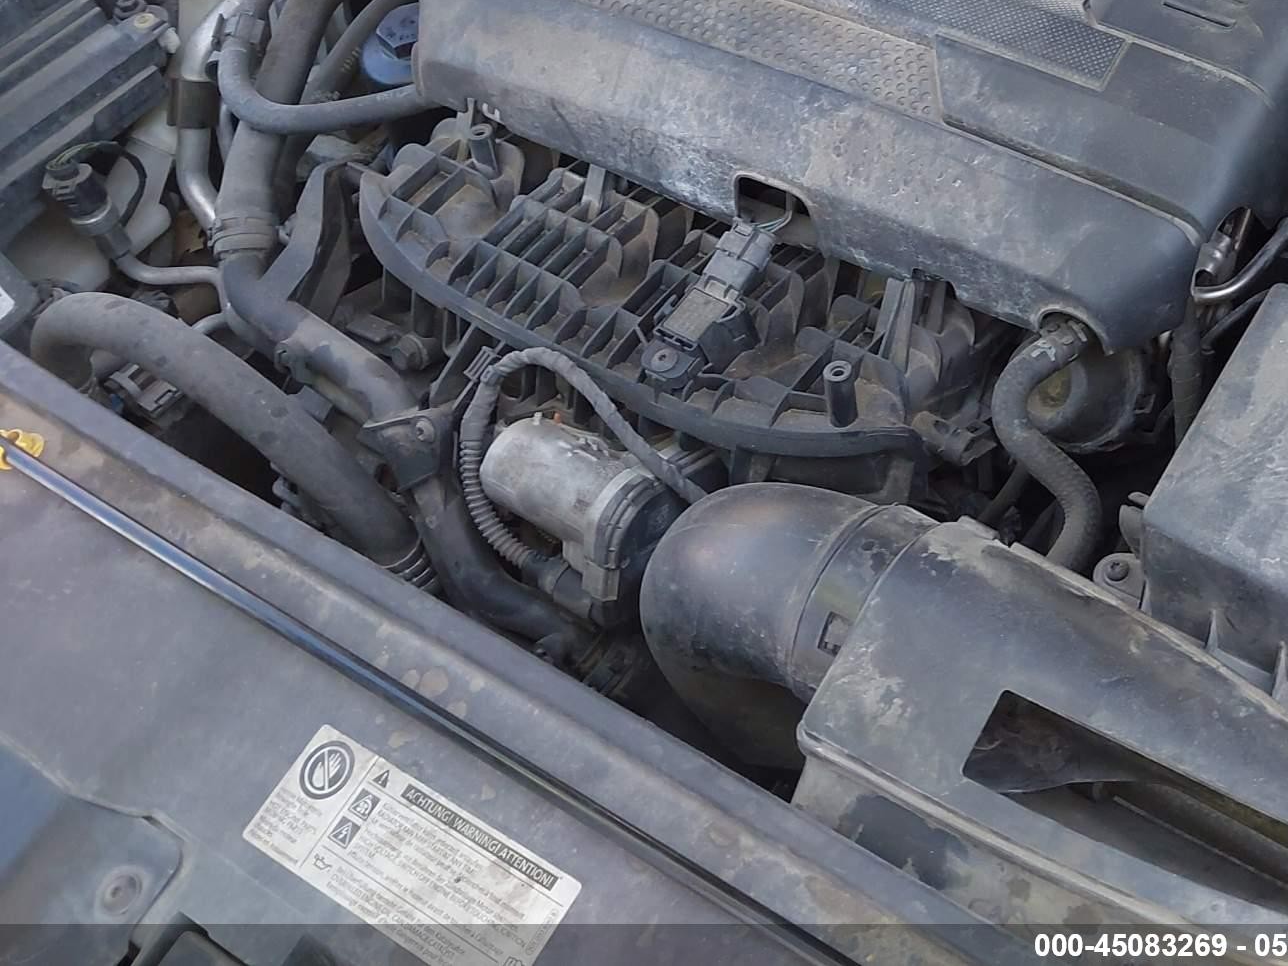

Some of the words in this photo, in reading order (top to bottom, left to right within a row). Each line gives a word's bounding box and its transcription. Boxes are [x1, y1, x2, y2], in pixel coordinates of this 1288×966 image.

[404, 787, 454, 823] ACHTUNG!
[452, 816, 501, 852] WARNING!
[497, 847, 554, 886] ATTENTION!
